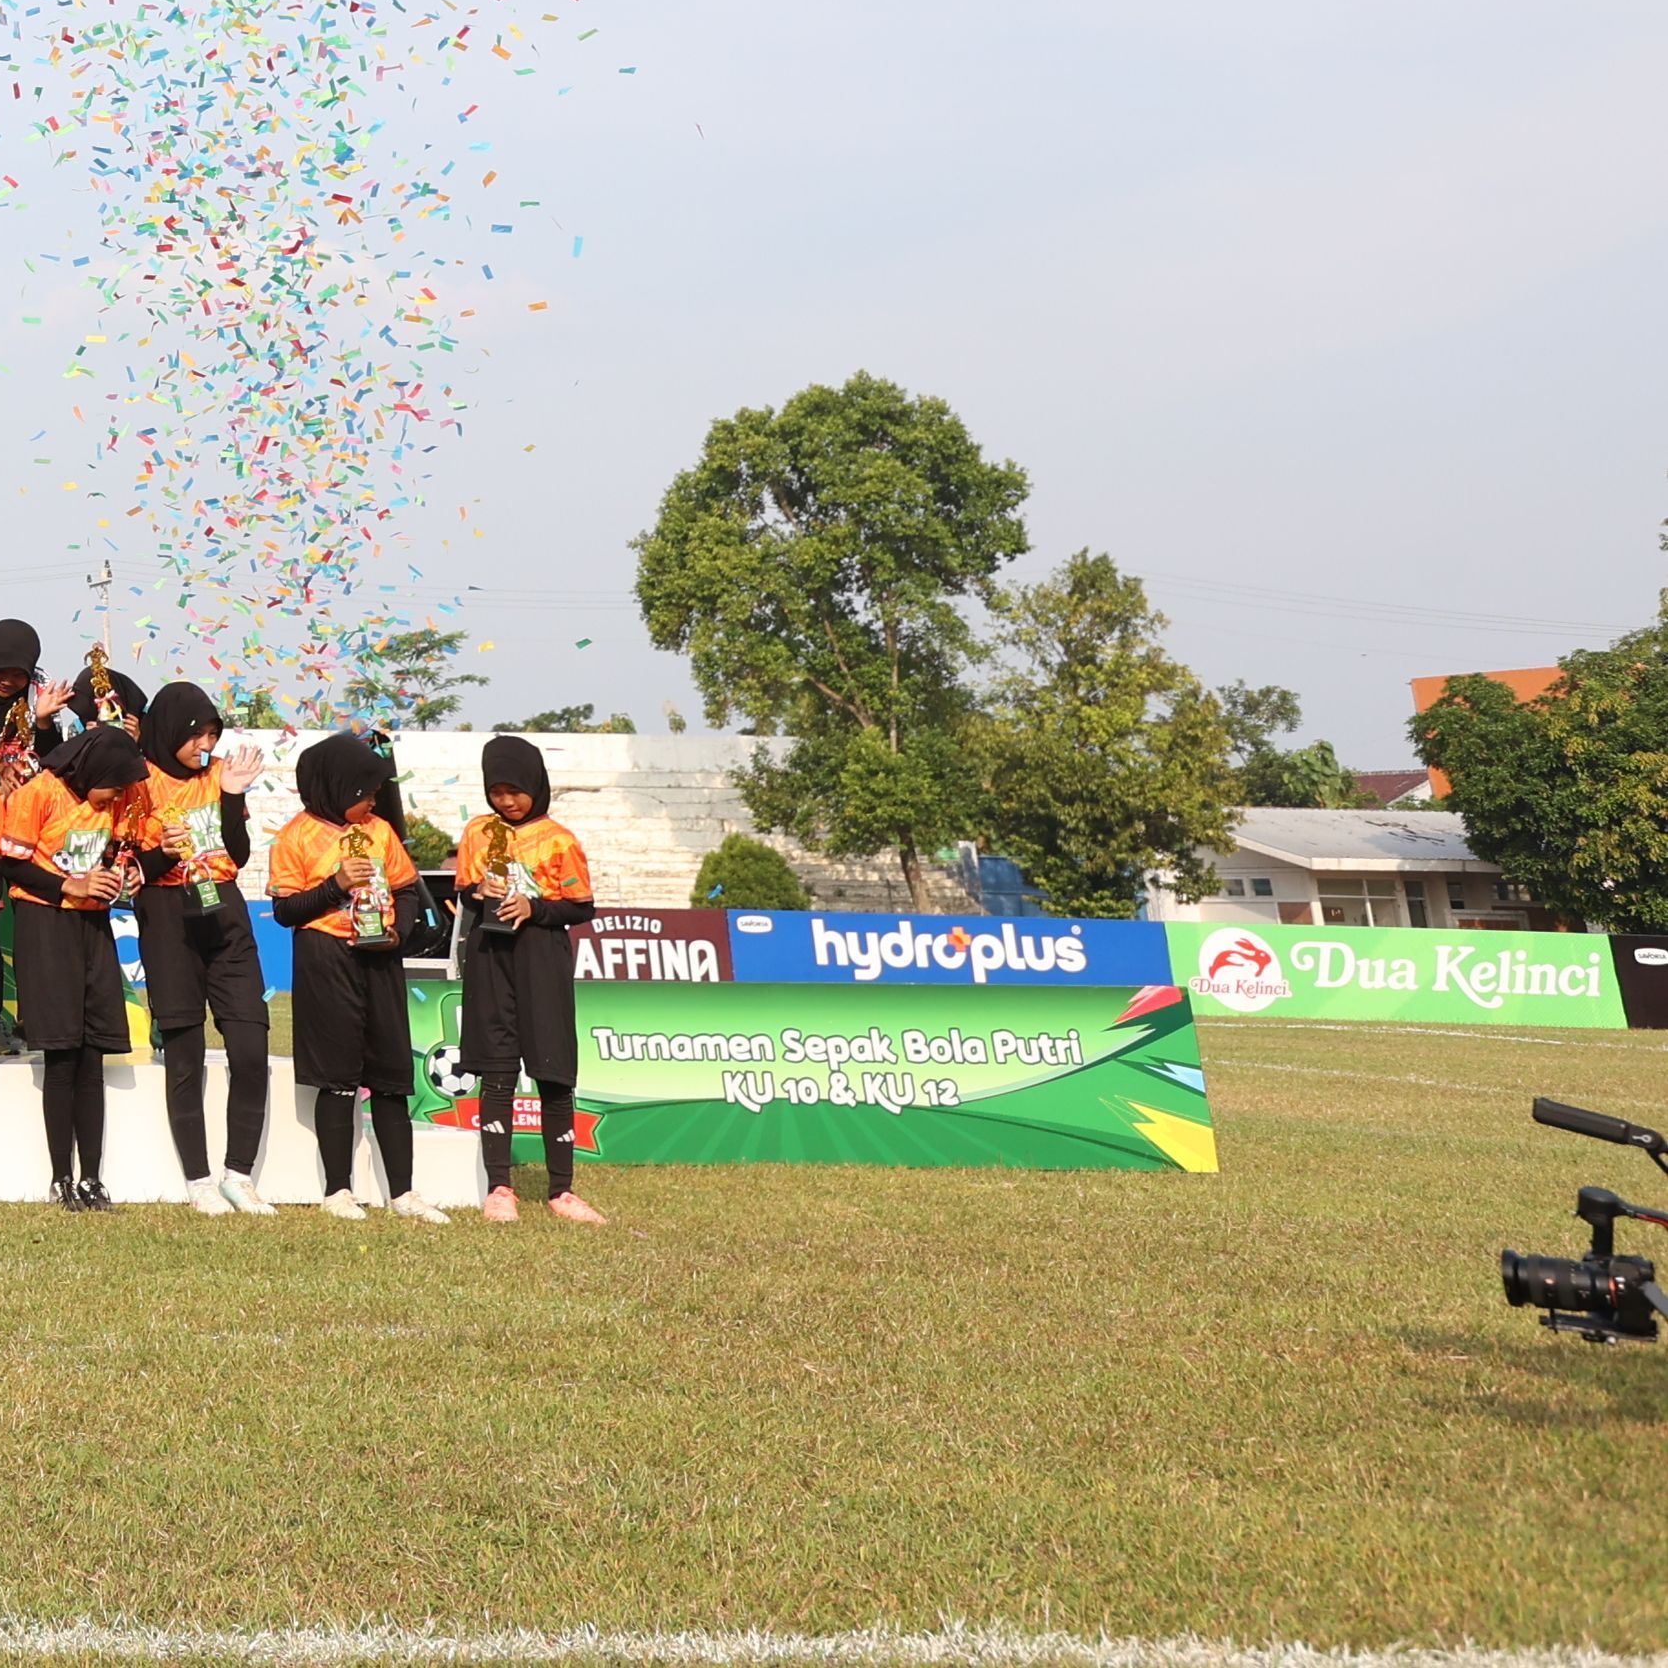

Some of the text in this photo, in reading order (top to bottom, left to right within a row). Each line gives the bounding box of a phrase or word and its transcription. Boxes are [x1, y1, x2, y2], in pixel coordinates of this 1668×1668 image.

[591, 916, 662, 934] DELIZIO
[574, 938, 719, 982] AFFINA
[811, 919, 1087, 983] hydroplus
[1190, 977, 1288, 998] Dua Kelinci
[1290, 940, 1601, 1009] Dua Kelinci
[591, 1027, 1084, 1070] Turnamen Sepak Bola Putri
[722, 1071, 961, 1115] KU 10 & KU 12
